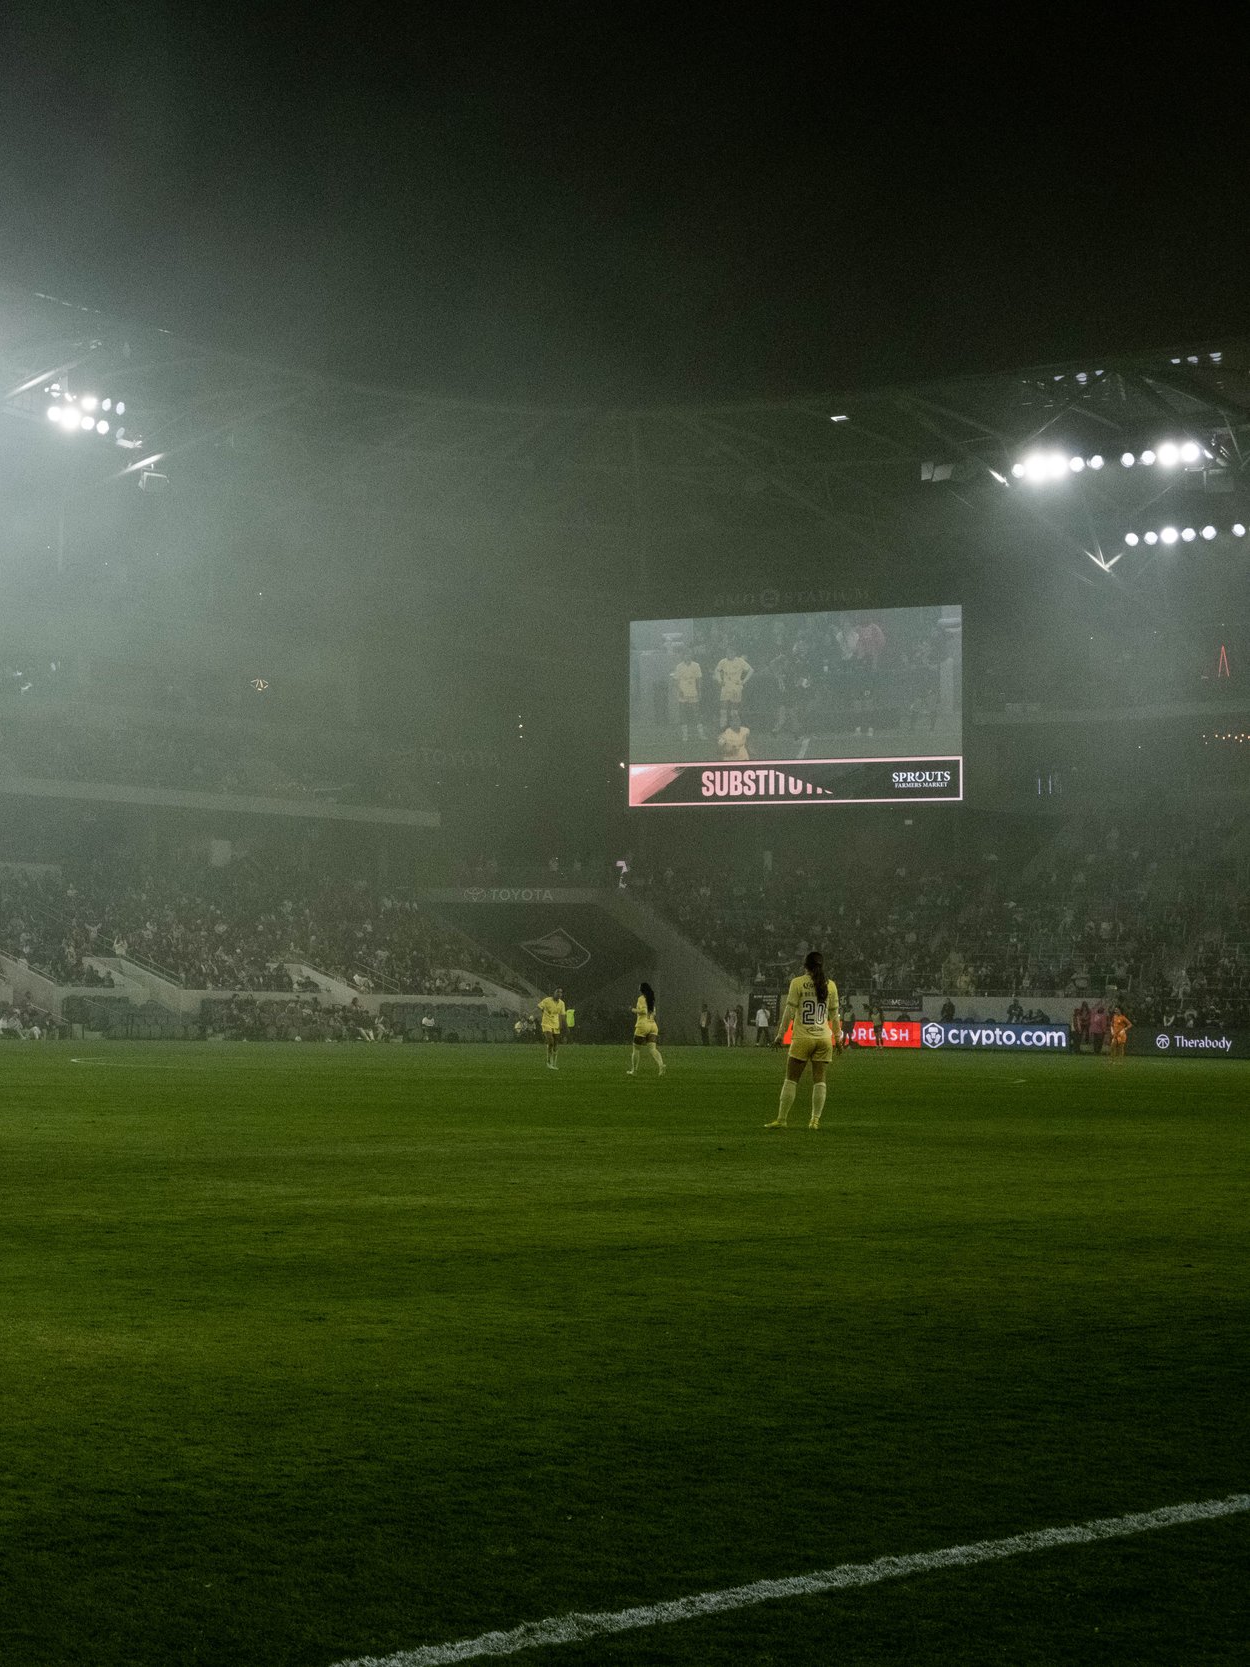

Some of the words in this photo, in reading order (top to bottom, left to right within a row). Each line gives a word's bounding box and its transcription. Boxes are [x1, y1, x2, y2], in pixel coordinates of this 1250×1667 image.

[701, 769, 834, 797] SUBSTITU
[892, 771, 951, 783] SPROUTS
[490, 888, 554, 901] TOYOTA
[802, 1000, 827, 1025] 20
[947, 1027, 1067, 1047] crypto.com
[1174, 1035, 1232, 1052] Therabody
